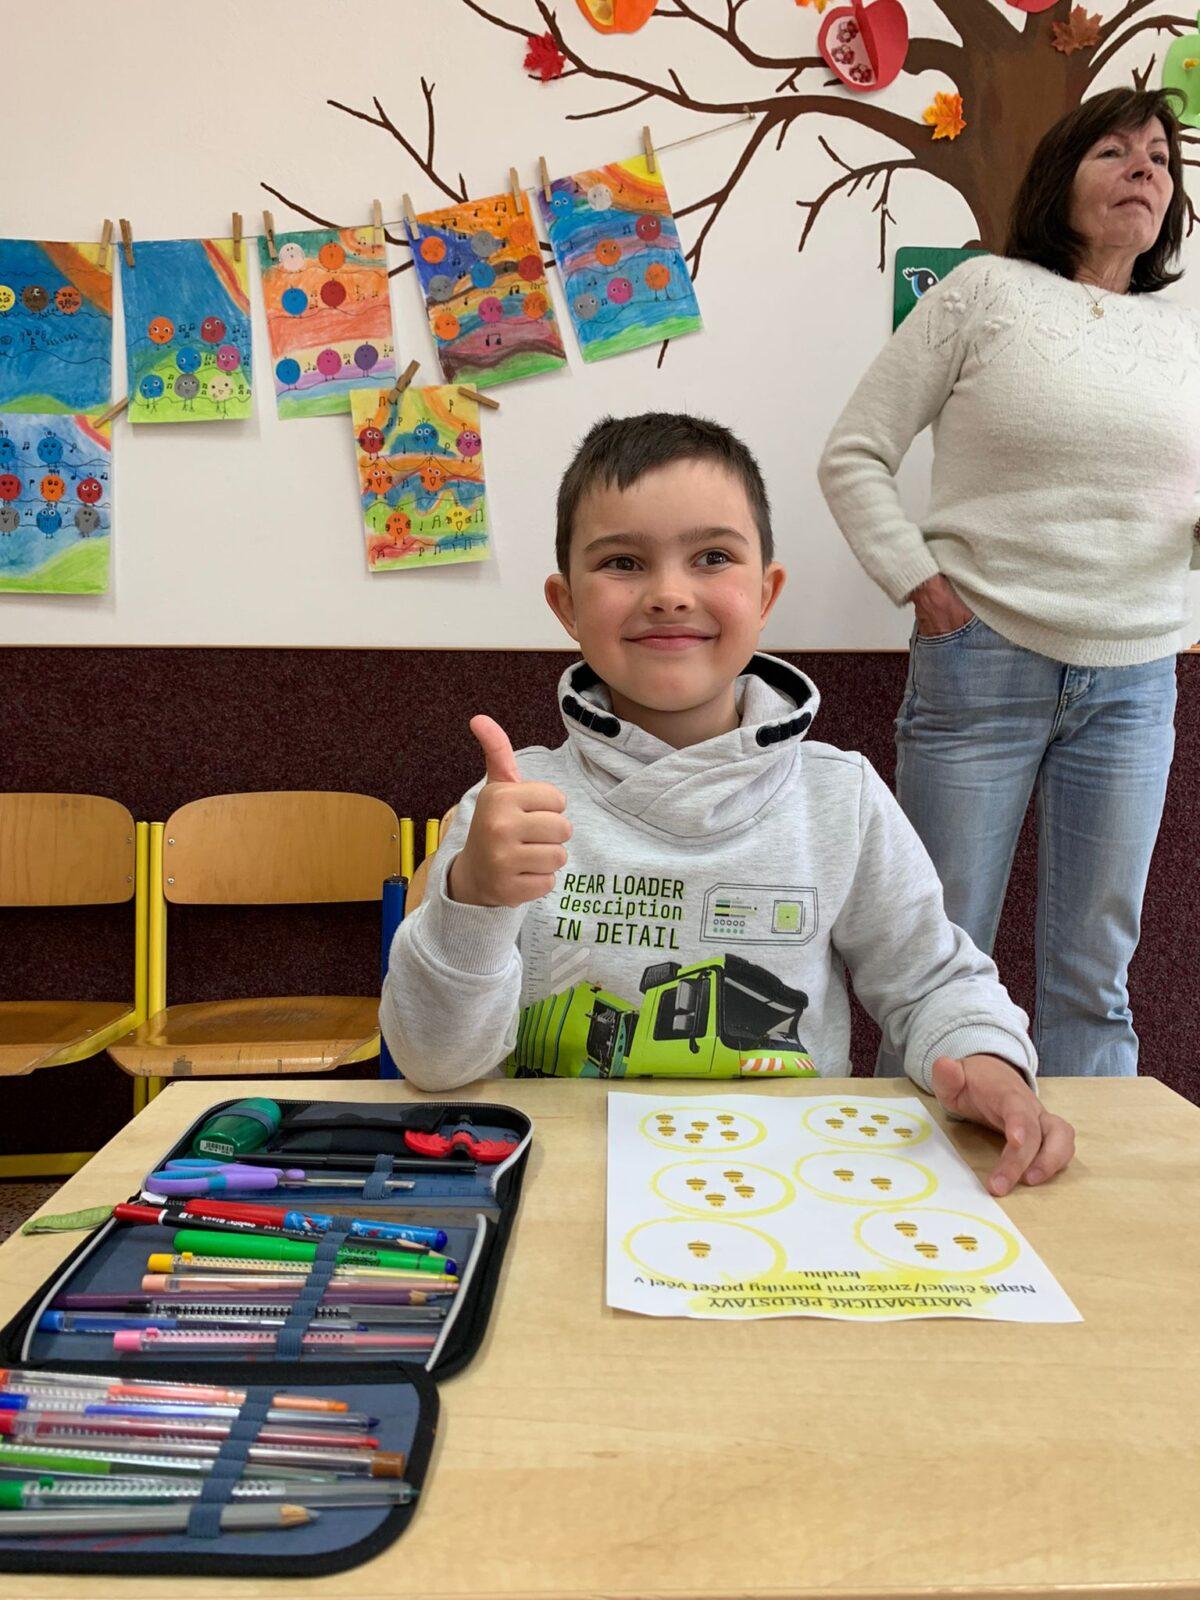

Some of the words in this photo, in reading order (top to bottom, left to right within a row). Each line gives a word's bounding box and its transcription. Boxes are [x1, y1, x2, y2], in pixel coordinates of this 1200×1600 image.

[563, 873, 606, 894] REAR
[612, 874, 685, 900] LOADER
[559, 894, 683, 921] description
[553, 916, 582, 941] IN
[594, 922, 680, 950] DETAIL
[634, 1276, 645, 1284] v
[798, 1270, 861, 1279] kruhu.
[650, 1278, 688, 1290] včel
[694, 1282, 745, 1293] počet
[749, 1282, 822, 1294] puntíky
[979, 1283, 1037, 1294] Napiš
[829, 1297, 973, 1309] MATEMATICKÉ
